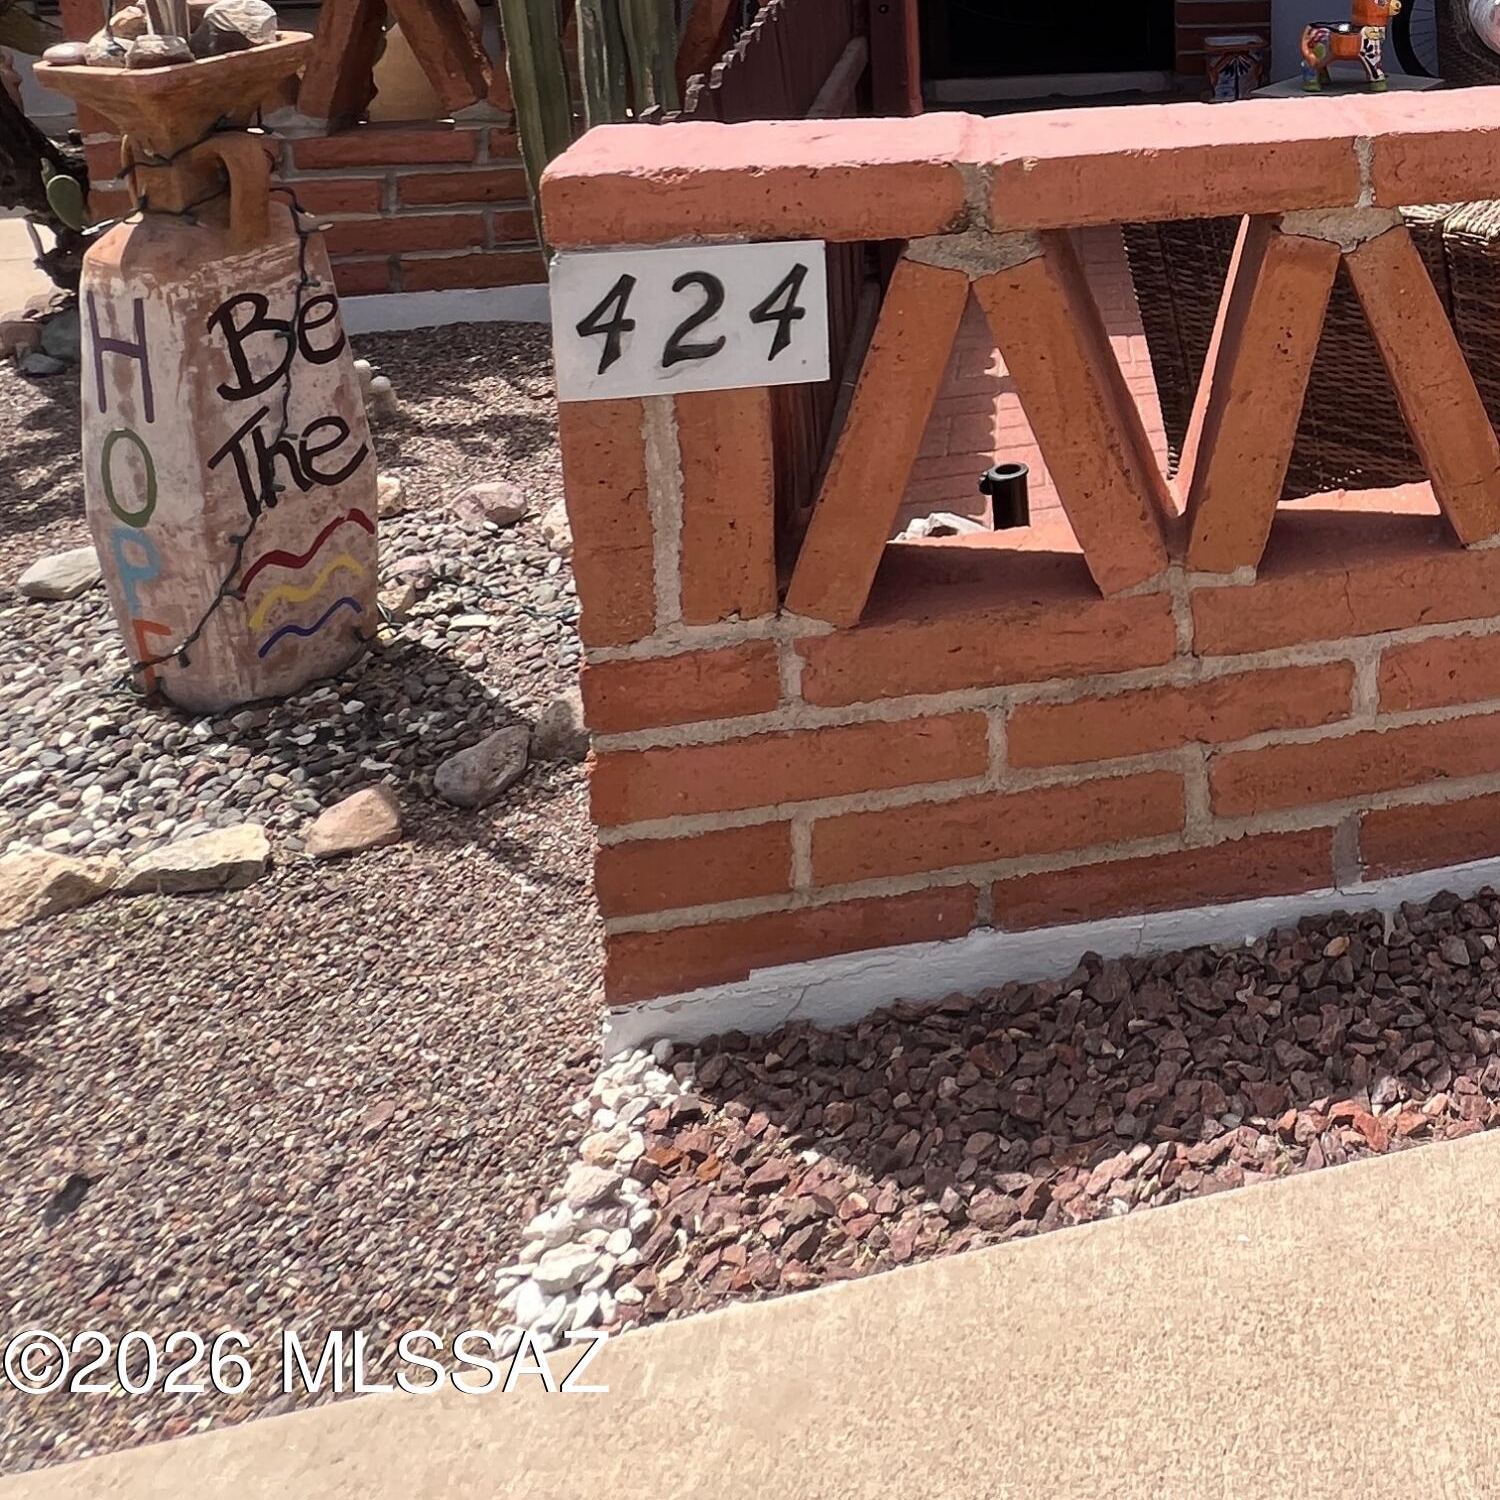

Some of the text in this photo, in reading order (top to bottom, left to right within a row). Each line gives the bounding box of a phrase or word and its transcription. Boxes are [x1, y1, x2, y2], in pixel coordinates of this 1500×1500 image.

[206, 292, 346, 401] Be
[576, 263, 809, 375] 424
[207, 406, 369, 518] The
